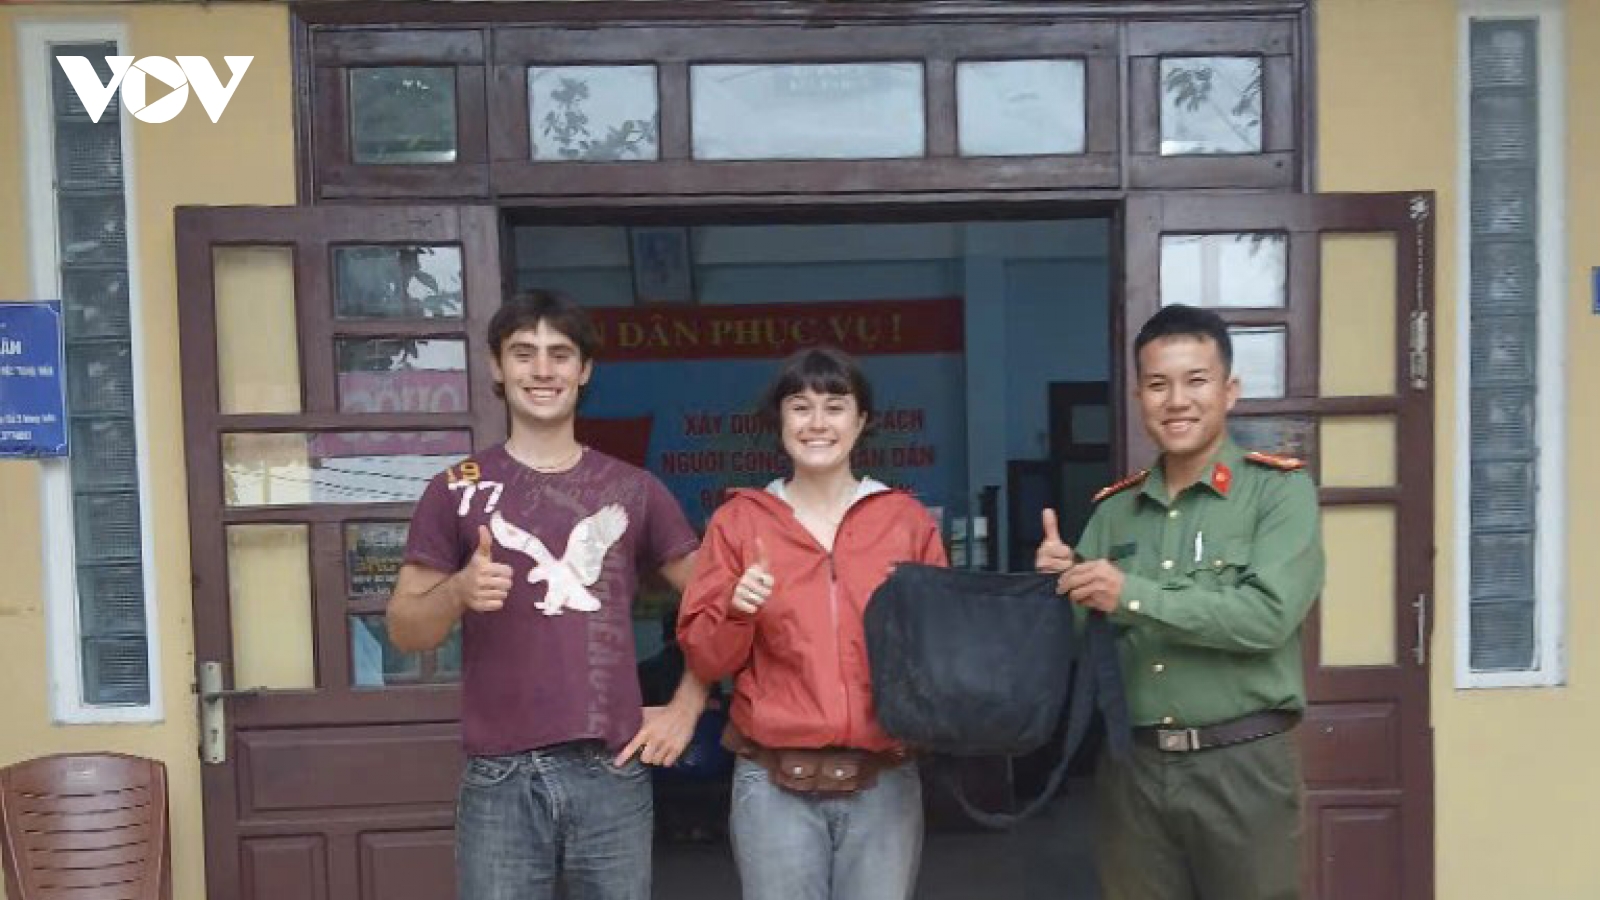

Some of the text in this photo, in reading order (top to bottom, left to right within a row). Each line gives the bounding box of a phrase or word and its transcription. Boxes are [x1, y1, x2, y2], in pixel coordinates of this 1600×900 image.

[617, 313, 700, 347] DÂN
[448, 461, 480, 484] 19
[448, 480, 504, 516] 77
